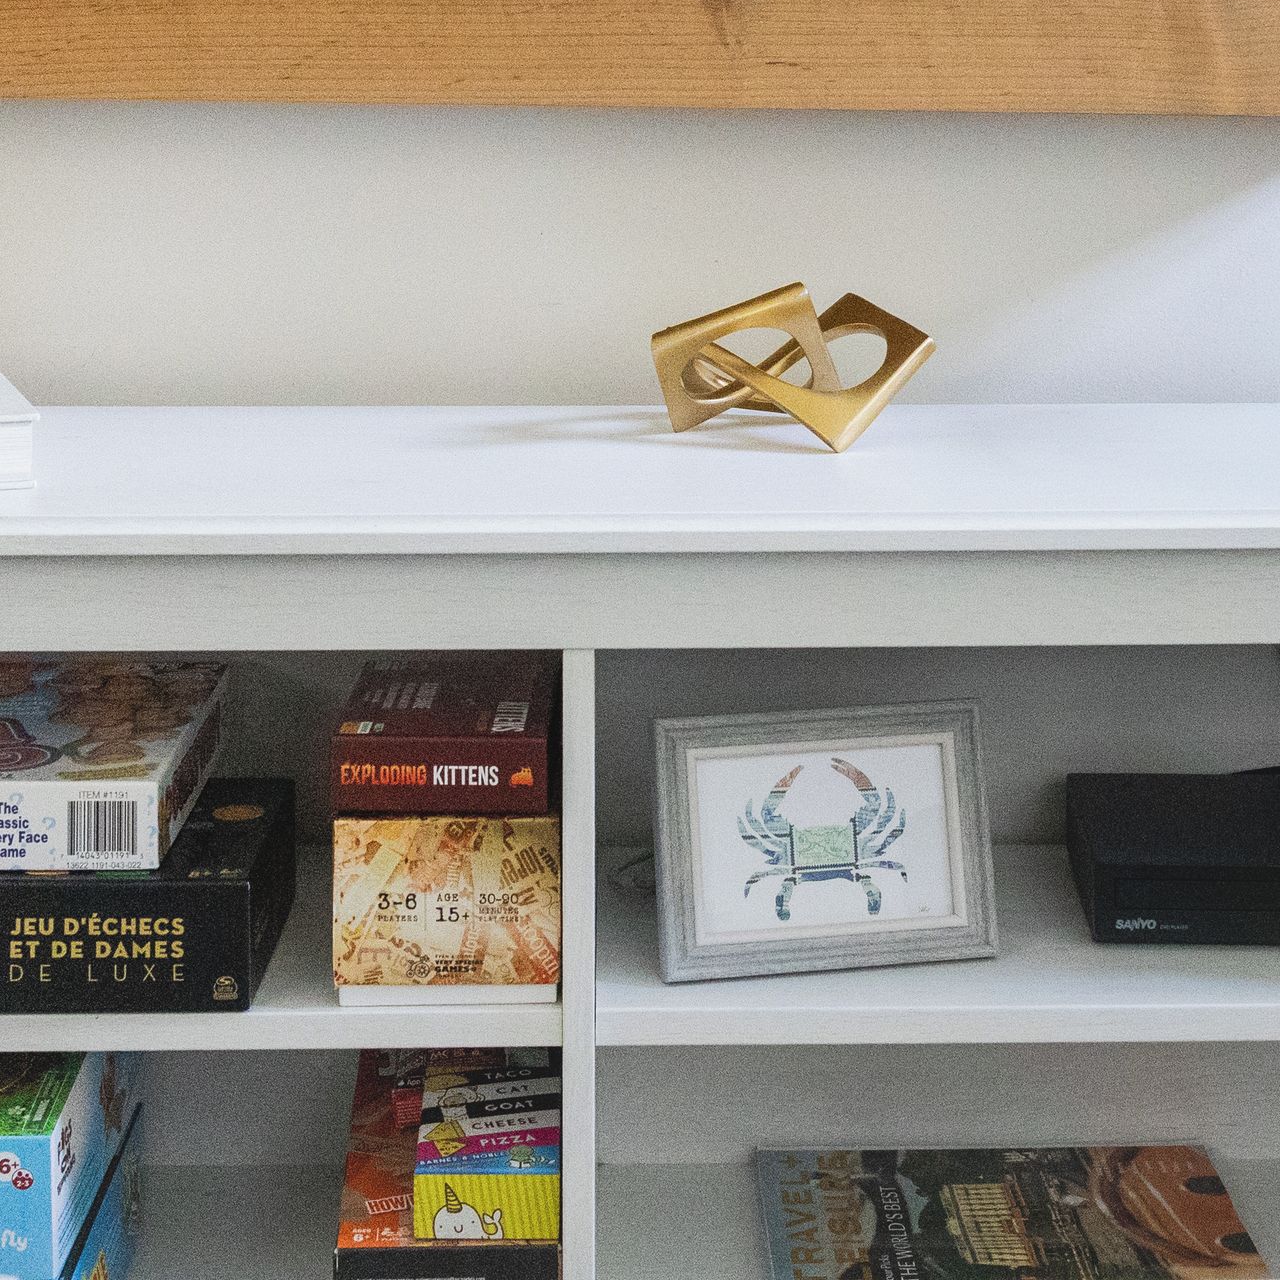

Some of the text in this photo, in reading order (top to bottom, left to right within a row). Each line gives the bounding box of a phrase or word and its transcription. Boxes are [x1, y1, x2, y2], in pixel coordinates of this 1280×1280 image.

[340, 762, 499, 786] EXPLODING KITTENS
[17, 832, 49, 844] Face
[436, 893, 459, 902] AGE
[377, 914, 418, 922] PLAYERS
[435, 907, 470, 923] 15+
[10, 912, 185, 936] JEU D'ÉCHECS
[1115, 918, 1157, 931] SANYO
[9, 941, 185, 959] ET DE DAMES
[9, 963, 185, 982] DE LUXE
[484, 1069, 532, 1080] TACO
[496, 1085, 529, 1094] CAT
[485, 1100, 534, 1111] GOAT
[472, 1117, 539, 1130] CHEESE
[480, 1134, 536, 1147] PIZZA
[366, 1195, 408, 1215] HOW
[880, 1186, 903, 1211] BEST
[0, 1228, 28, 1252] fly
[885, 1211, 914, 1260] WORLD'S
